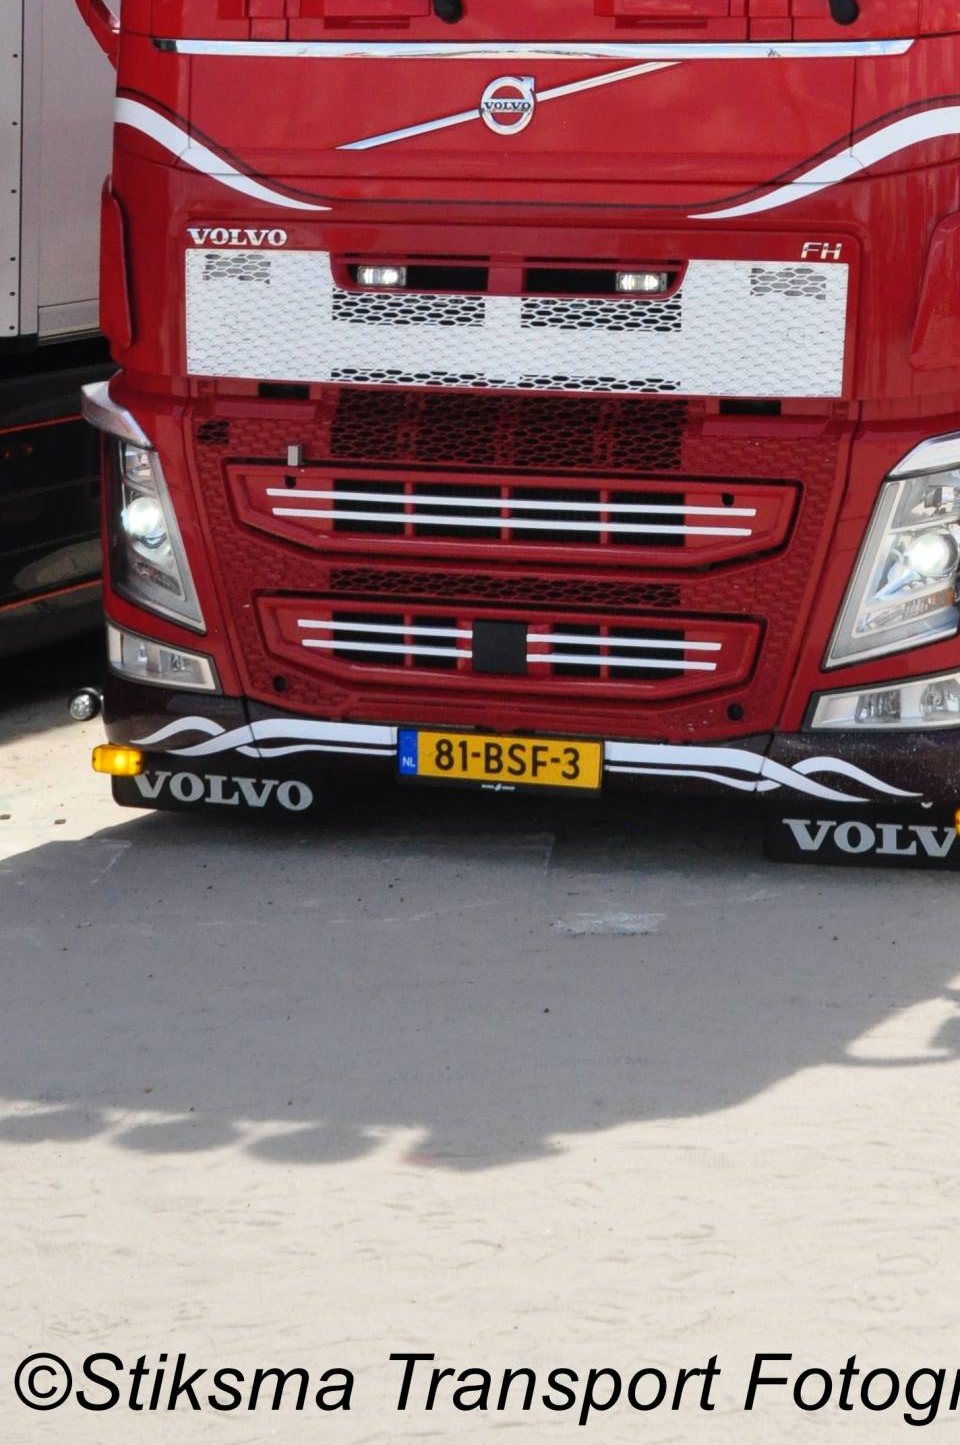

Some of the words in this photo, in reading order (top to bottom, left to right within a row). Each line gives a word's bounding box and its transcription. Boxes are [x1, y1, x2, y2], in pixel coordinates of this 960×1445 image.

[484, 101, 531, 111] VOLVO
[186, 227, 288, 246] VOLVO
[800, 242, 842, 260] FH
[402, 756, 416, 767] NL
[434, 738, 580, 780] 81-BSF-3
[133, 770, 314, 811] VOLVO
